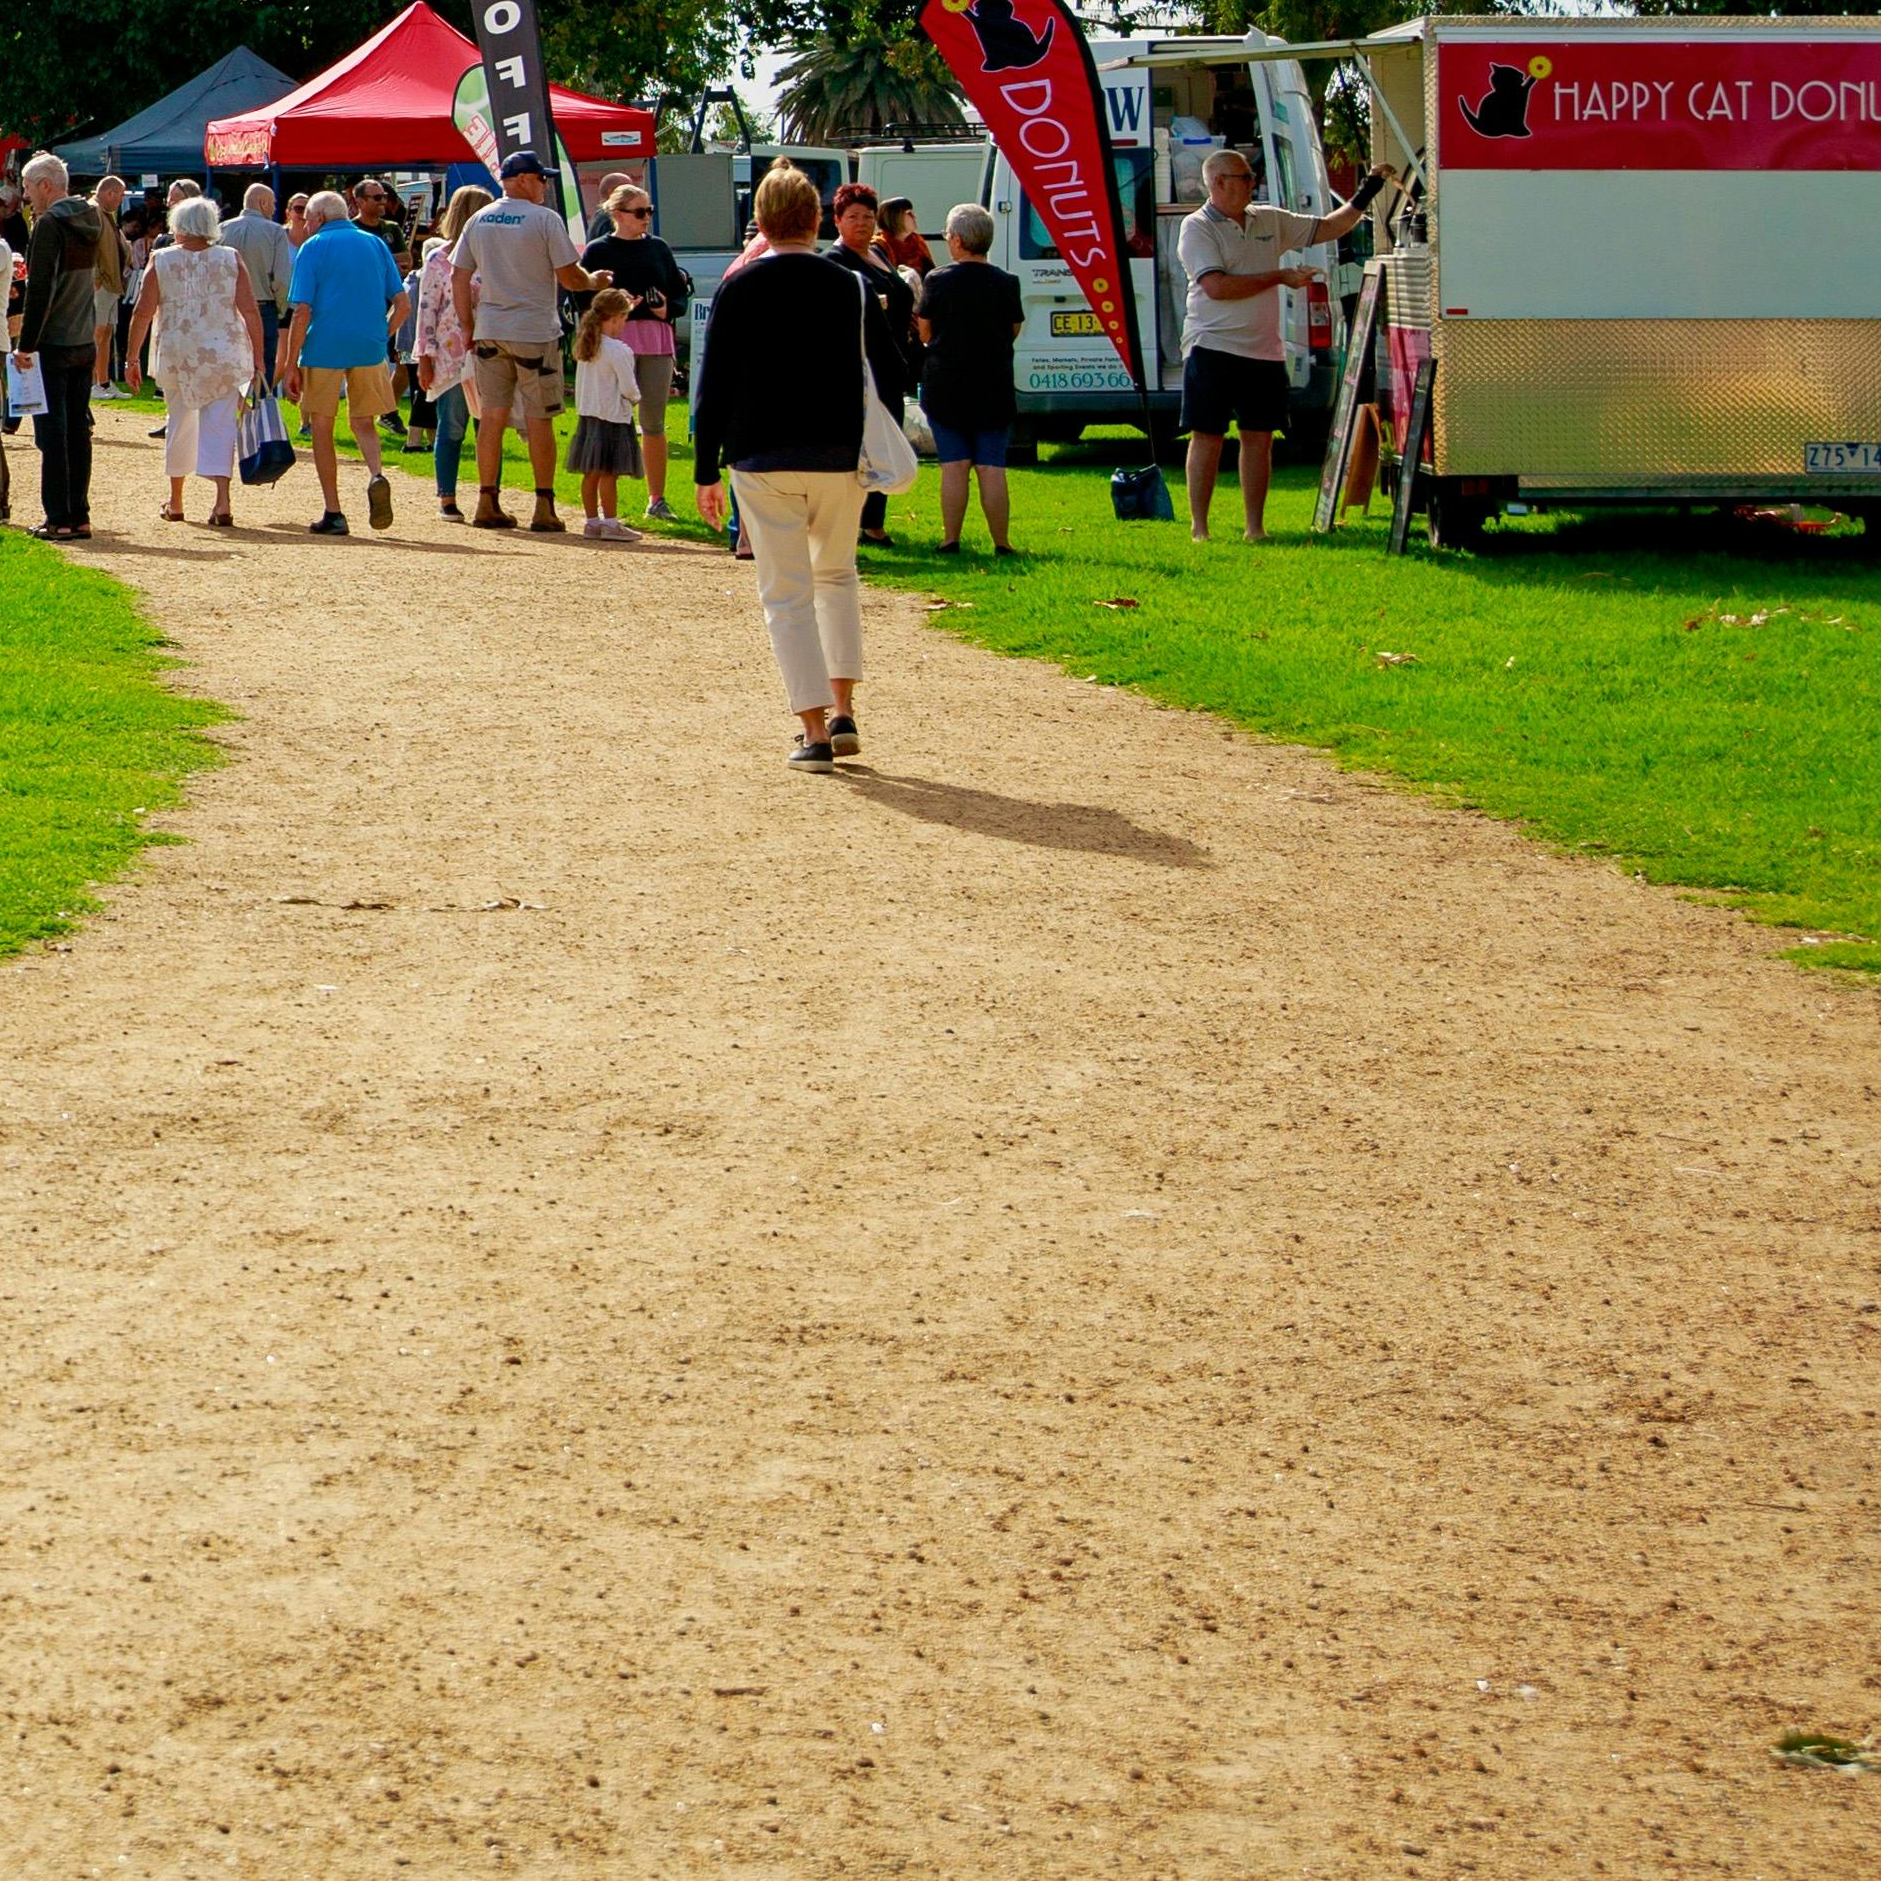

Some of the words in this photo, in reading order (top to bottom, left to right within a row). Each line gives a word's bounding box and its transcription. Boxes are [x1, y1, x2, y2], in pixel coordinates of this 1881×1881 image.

[1554, 81, 1674, 121] HAPPY
[1688, 81, 1753, 121] CAT
[1000, 78, 1106, 267] DONUTS
[1029, 372, 1068, 389] 0418
[1071, 372, 1104, 388] 693
[1107, 372, 1131, 388] 66
